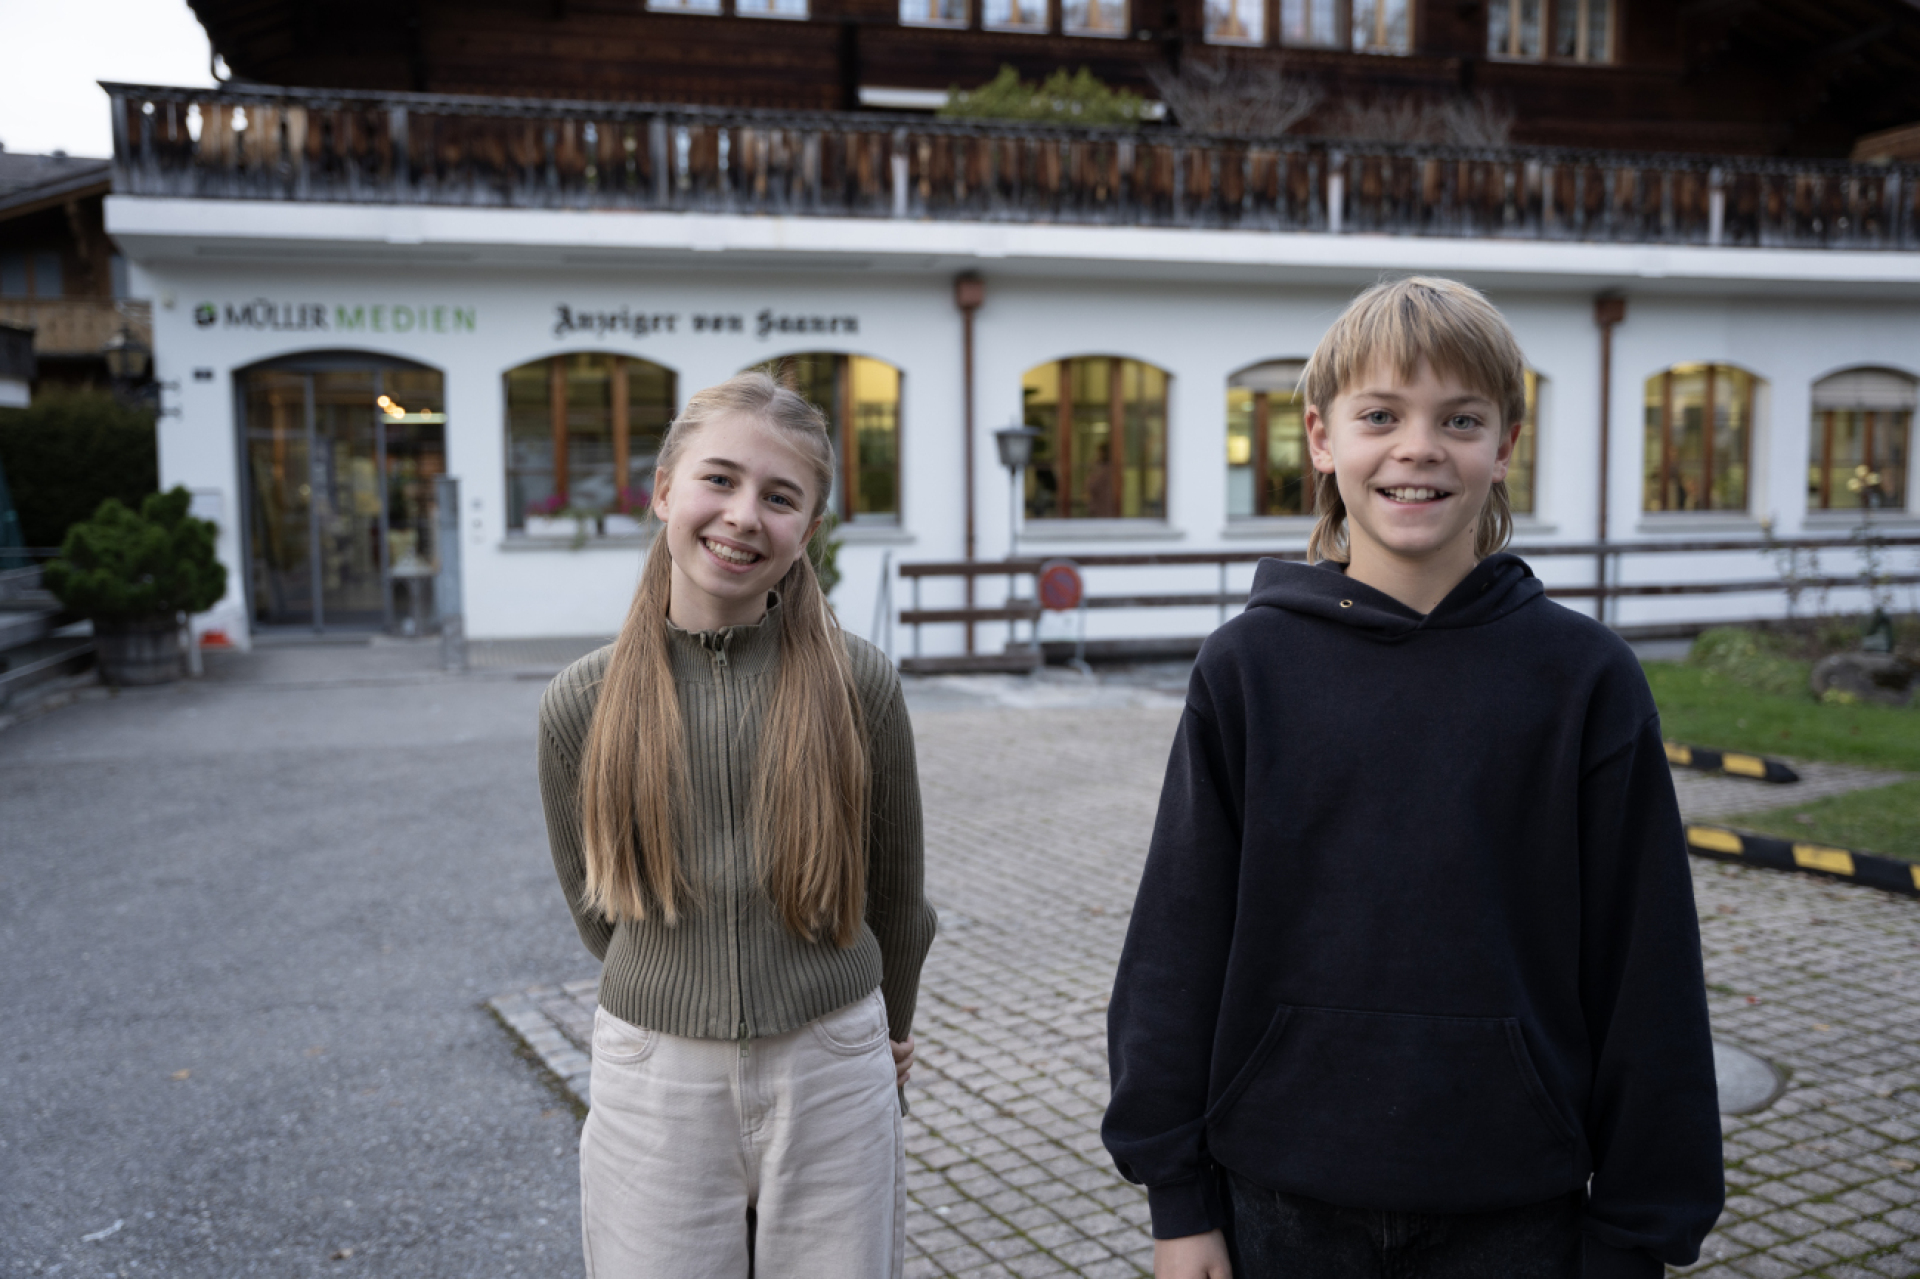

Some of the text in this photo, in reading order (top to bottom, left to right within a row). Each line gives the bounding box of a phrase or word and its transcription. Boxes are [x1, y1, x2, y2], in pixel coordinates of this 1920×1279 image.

[223, 298, 477, 332] MÜLLER MEDIEN
[554, 304, 859, 338] Anzeiger von Saanen
